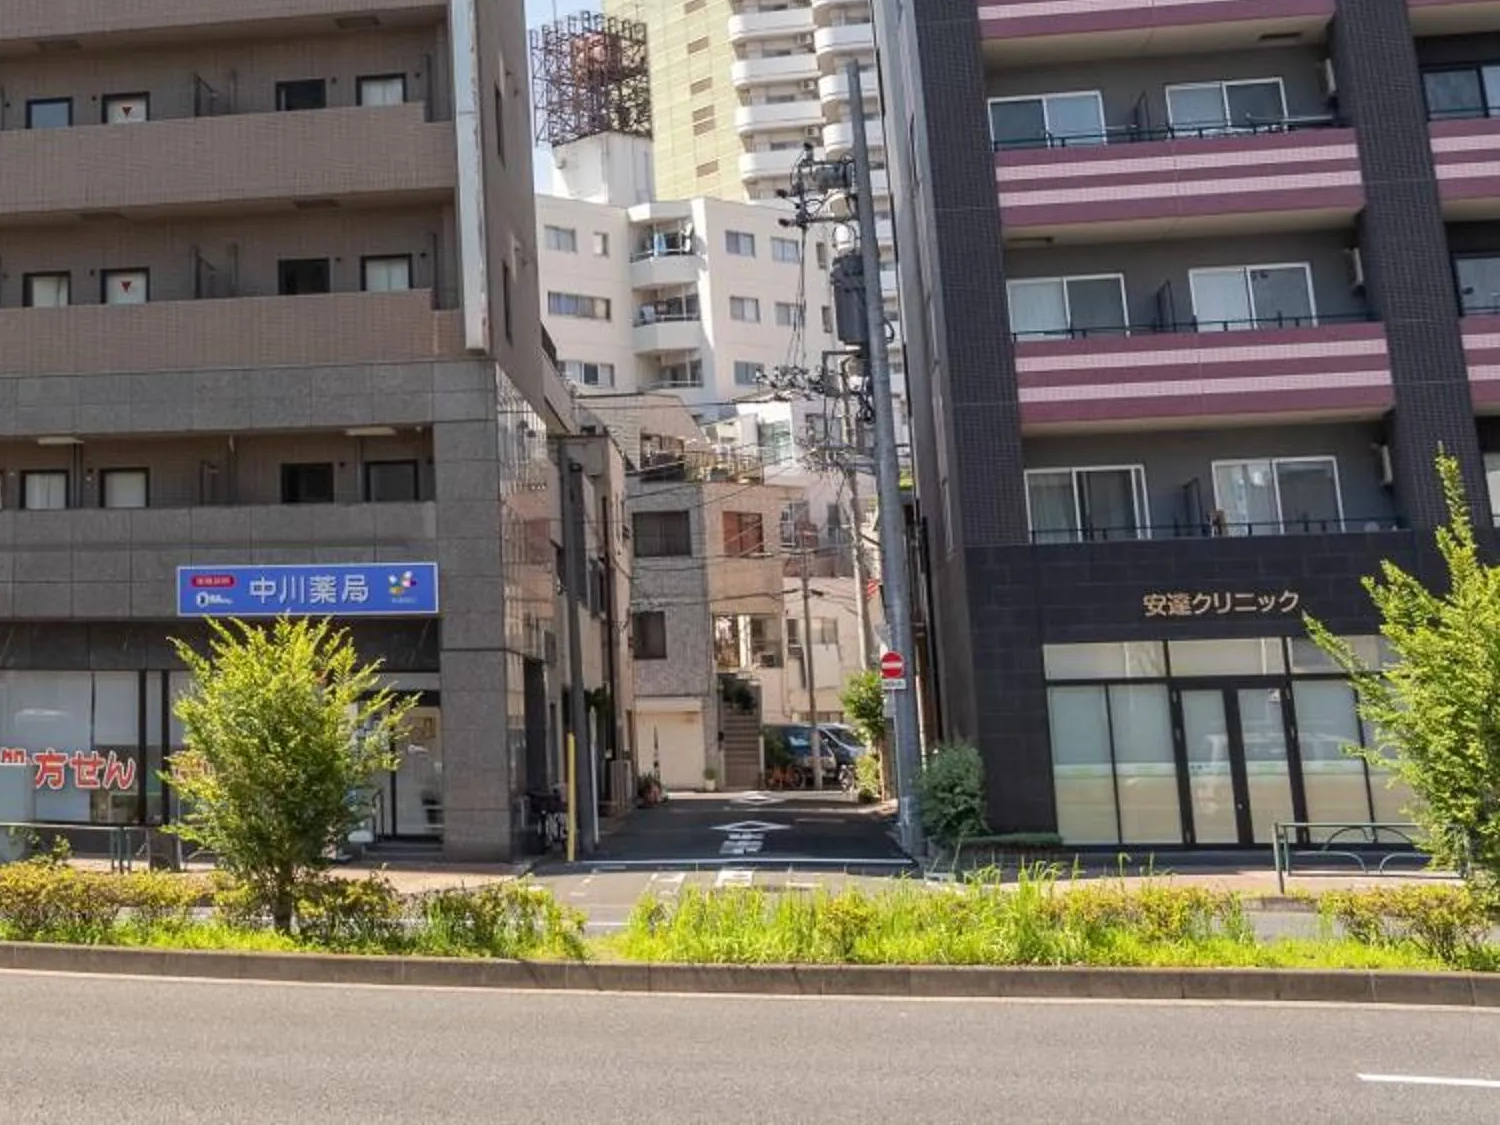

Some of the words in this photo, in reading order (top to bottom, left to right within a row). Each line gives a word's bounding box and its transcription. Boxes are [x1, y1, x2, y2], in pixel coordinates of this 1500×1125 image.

[250, 574, 369, 604] 中川薬局
[1143, 589, 1299, 617] 安達クリニック
